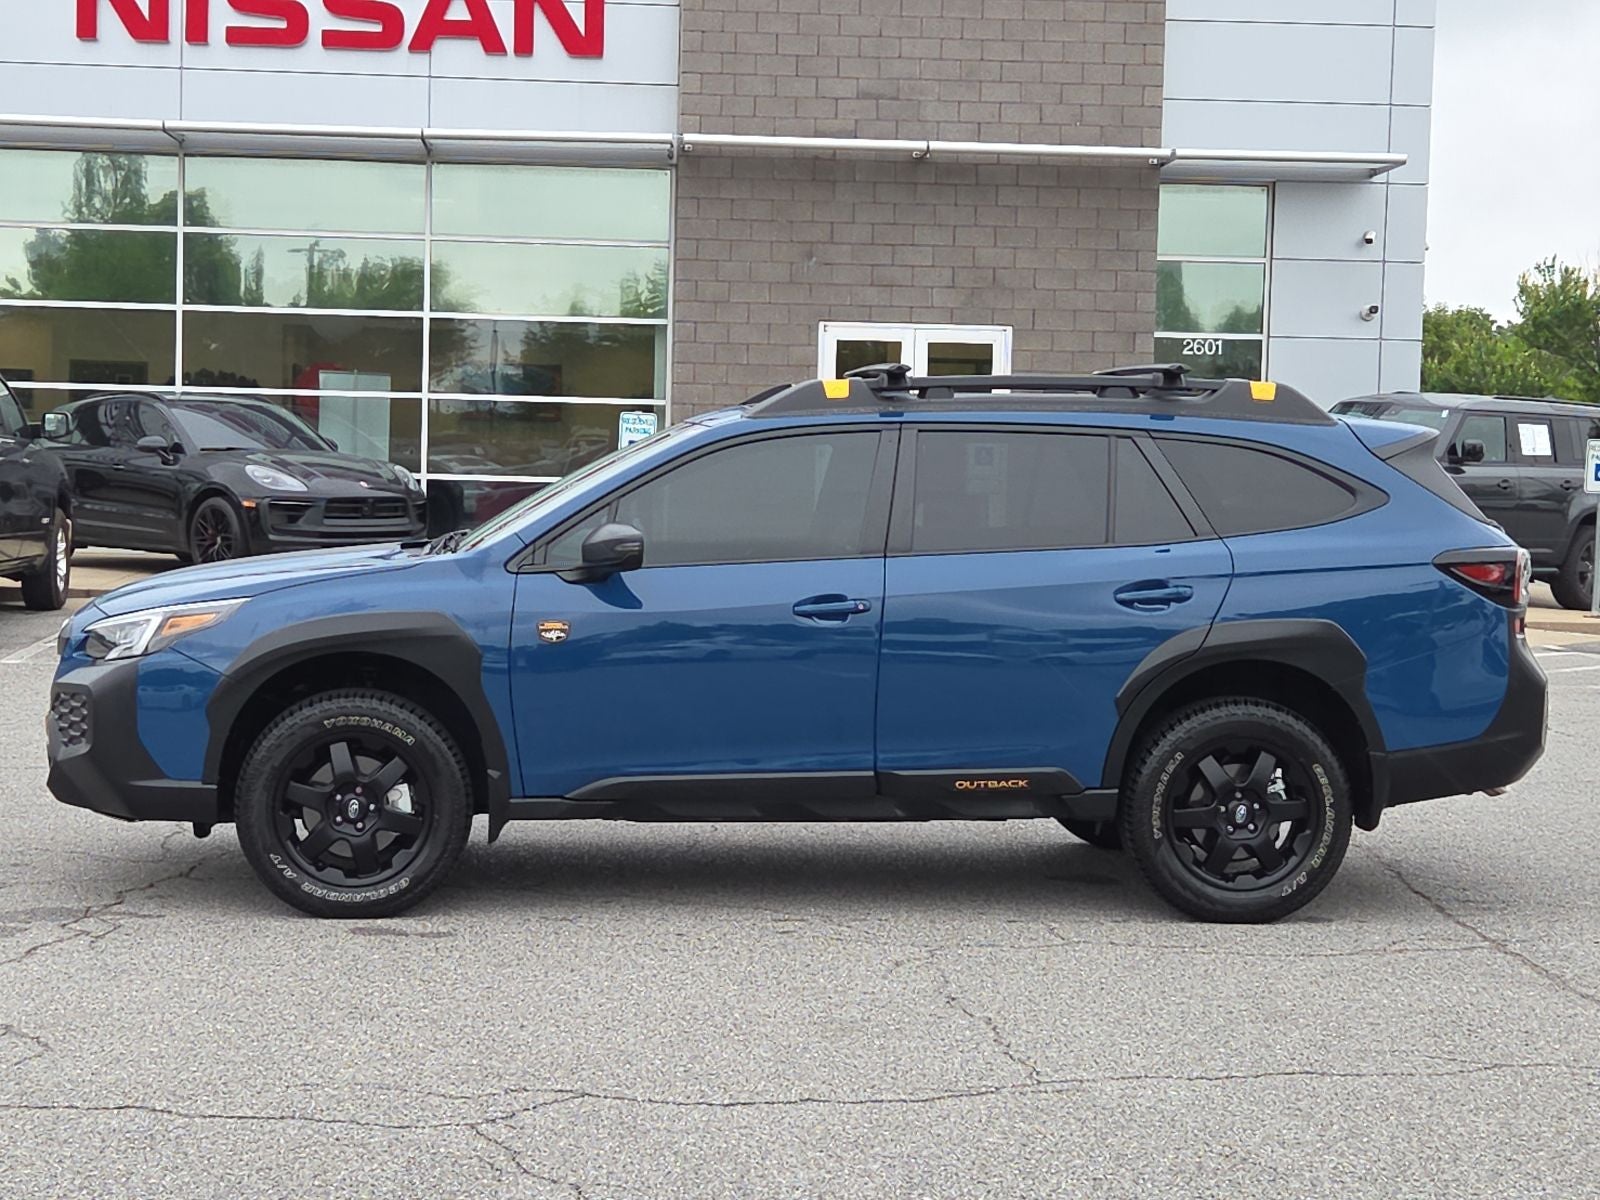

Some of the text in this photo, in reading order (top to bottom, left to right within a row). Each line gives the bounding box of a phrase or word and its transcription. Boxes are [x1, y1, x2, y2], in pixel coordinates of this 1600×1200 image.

[76, 0, 604, 58] NISSAN
[1182, 338, 1223, 356] 2601
[323, 715, 416, 746] YOKOHAMA
[954, 779, 1029, 790] OUTBACK
[1151, 751, 1185, 840] YOKOHAMA
[1281, 763, 1336, 897] GEOLANDAR A/T
[269, 853, 410, 903] GEOLANDAR A/T
